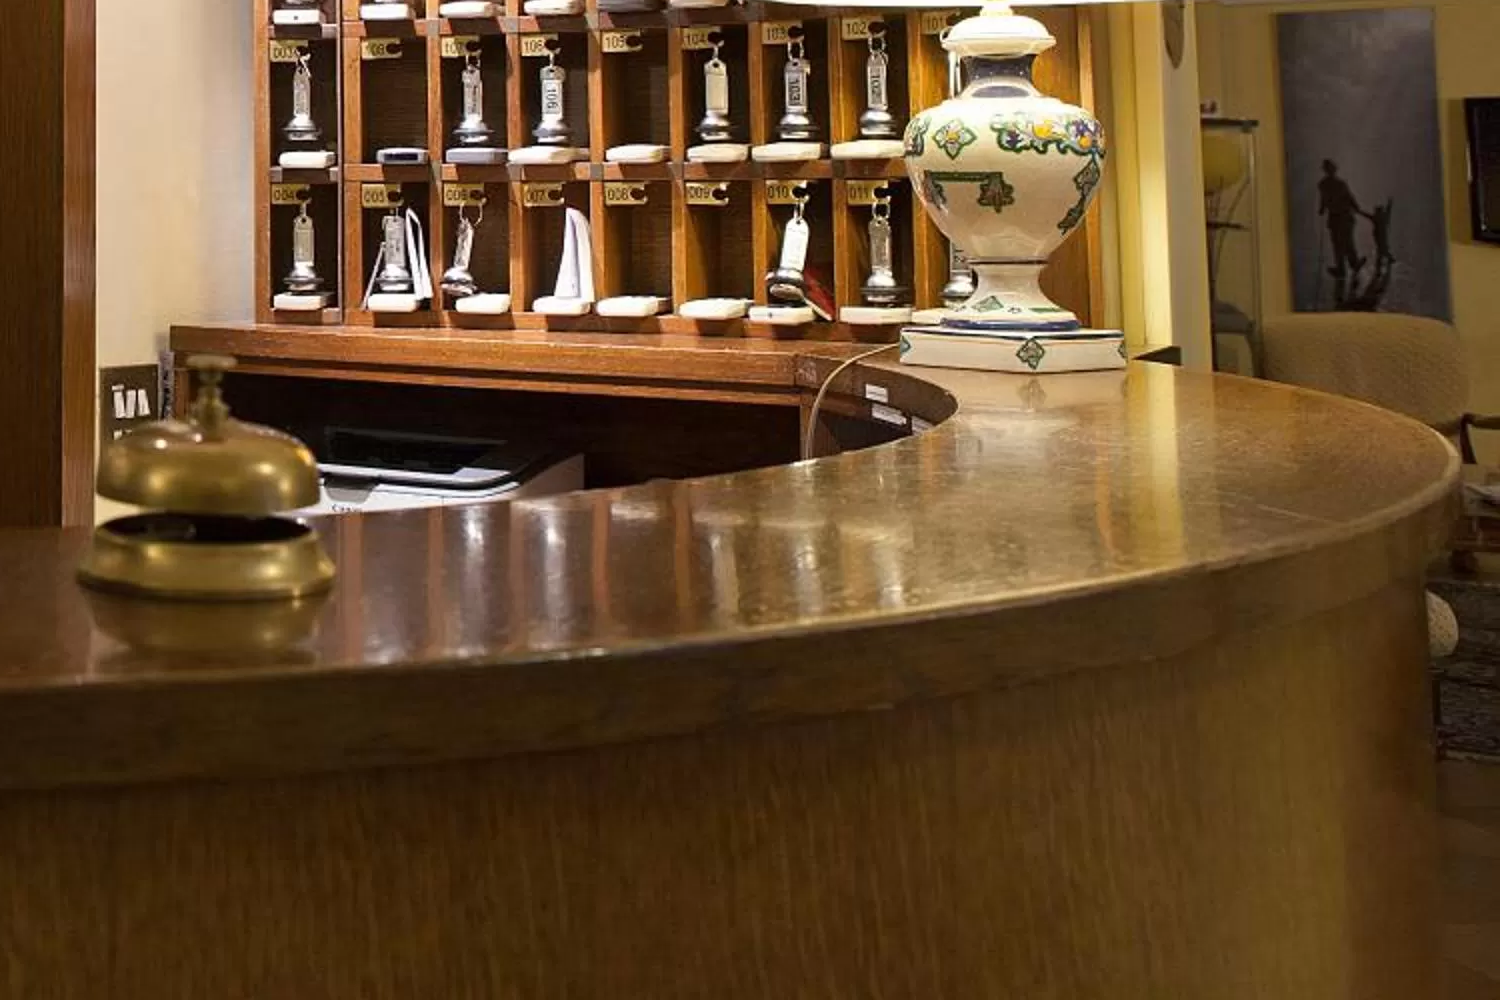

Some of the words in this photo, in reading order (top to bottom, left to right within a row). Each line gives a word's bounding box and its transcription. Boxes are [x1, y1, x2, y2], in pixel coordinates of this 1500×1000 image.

[846, 22, 867, 35] 102
[767, 185, 789, 199] 010
[849, 185, 870, 199] 011
